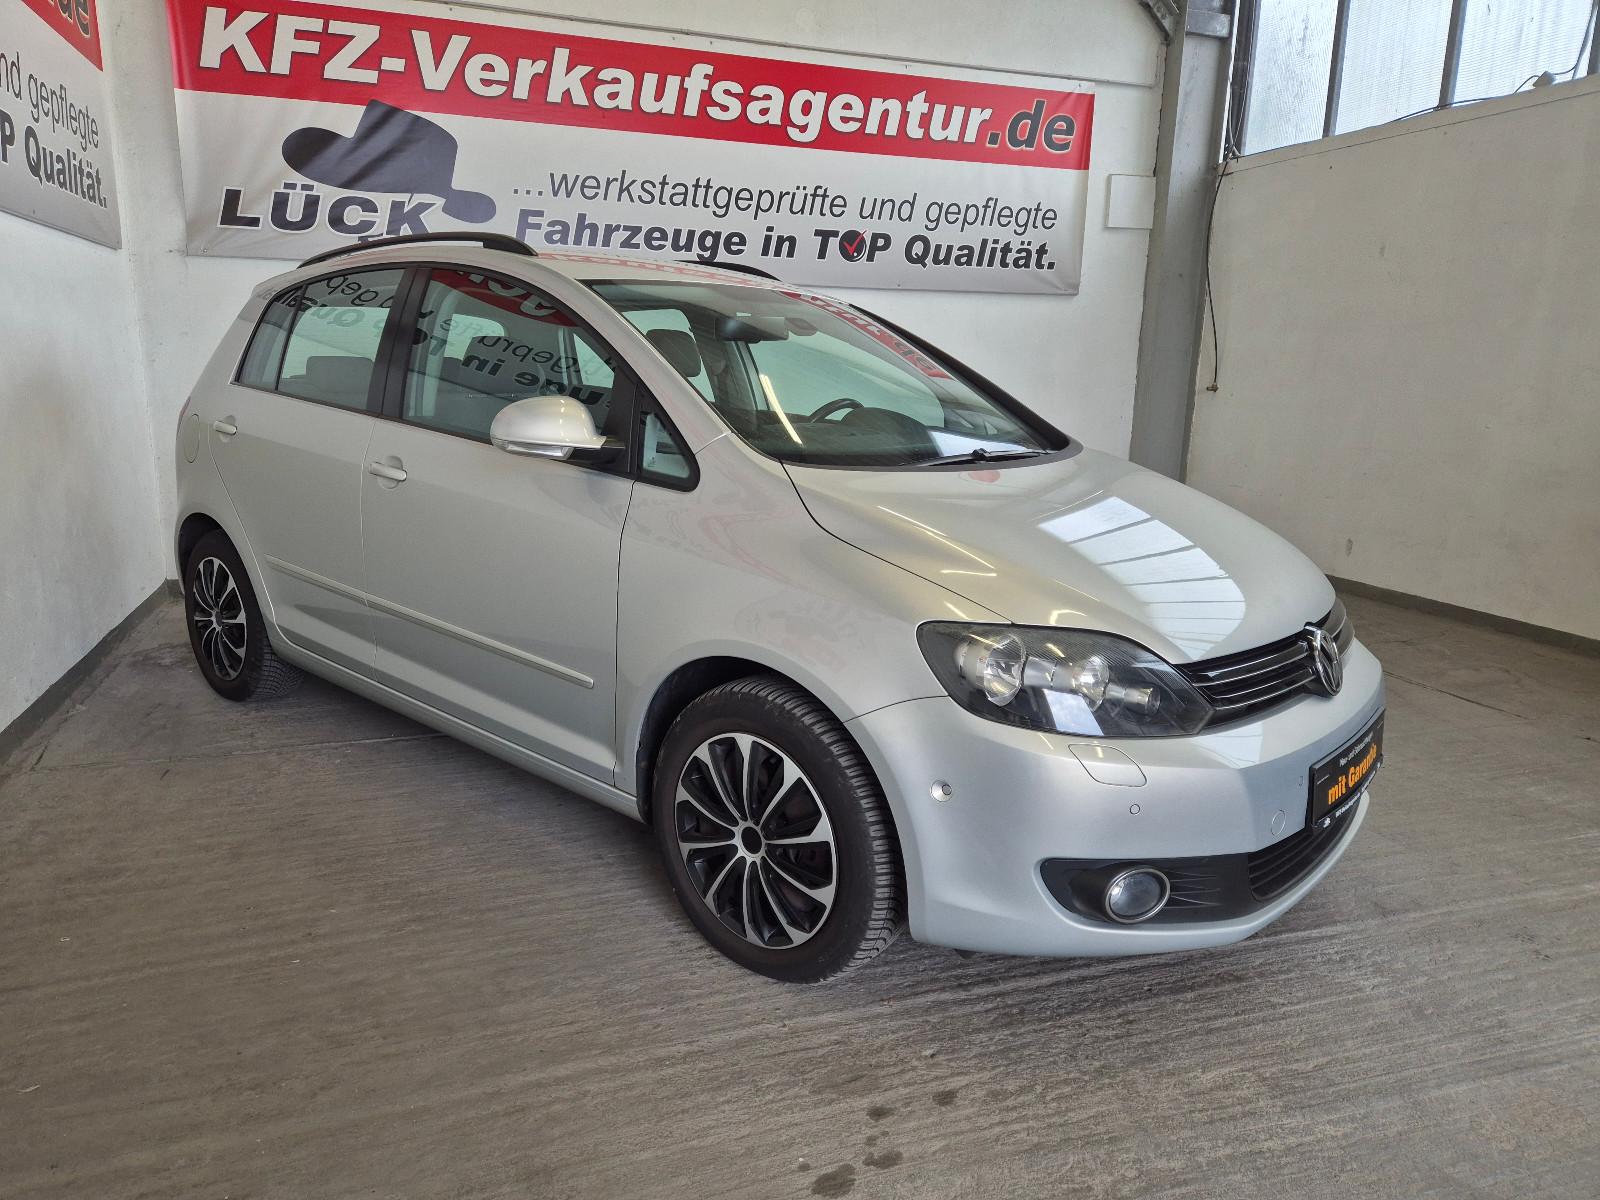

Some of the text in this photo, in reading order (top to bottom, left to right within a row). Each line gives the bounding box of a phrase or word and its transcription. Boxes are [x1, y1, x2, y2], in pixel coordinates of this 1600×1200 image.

[28, 73, 99, 152] gepflegte
[200, 6, 1077, 154] KFZ-Verkaufsagentur.de
[25, 125, 107, 208] Qualität.
[219, 182, 438, 236] LÜCK
[513, 169, 1059, 237] ...werkstattgeprüfte und gepflegte
[515, 208, 1056, 271] Fahrzeuge in TOP Qualität.
[1328, 775, 1346, 805] mit
